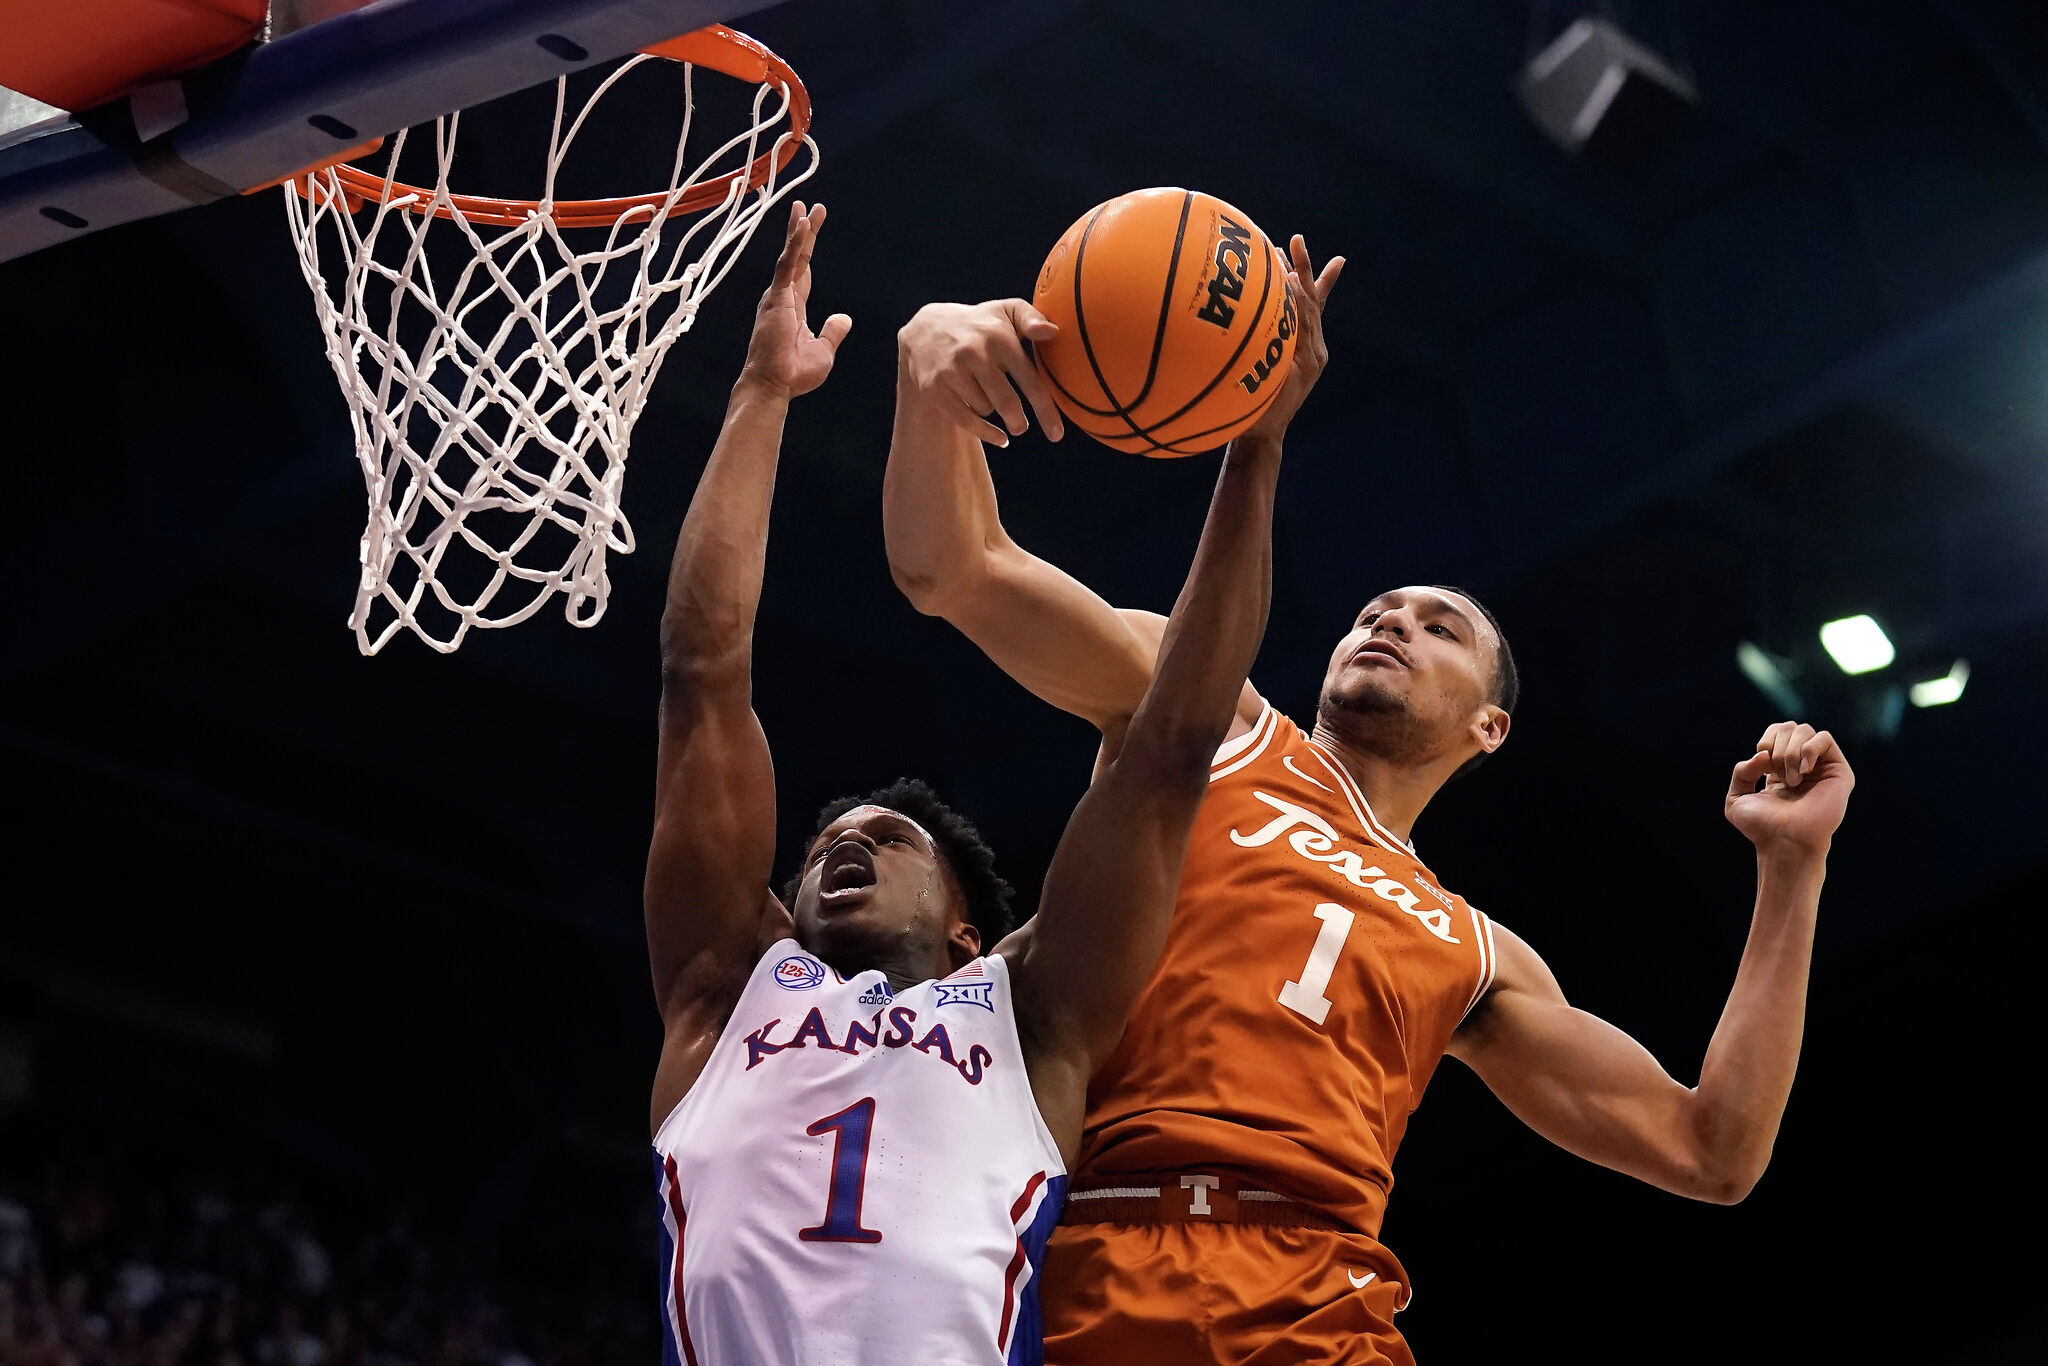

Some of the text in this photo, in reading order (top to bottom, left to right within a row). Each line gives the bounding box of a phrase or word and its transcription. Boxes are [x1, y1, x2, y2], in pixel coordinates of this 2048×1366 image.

[1196, 212, 1252, 330] NCAA
[1229, 790, 1461, 944] Texas
[778, 962, 806, 978] 125
[858, 994, 893, 1006] adida
[936, 984, 992, 1010] XII
[1278, 902, 1355, 1026] 1
[743, 1006, 993, 1086] KANSAS
[798, 1096, 883, 1244] 1
[1180, 1174, 1220, 1216] T
